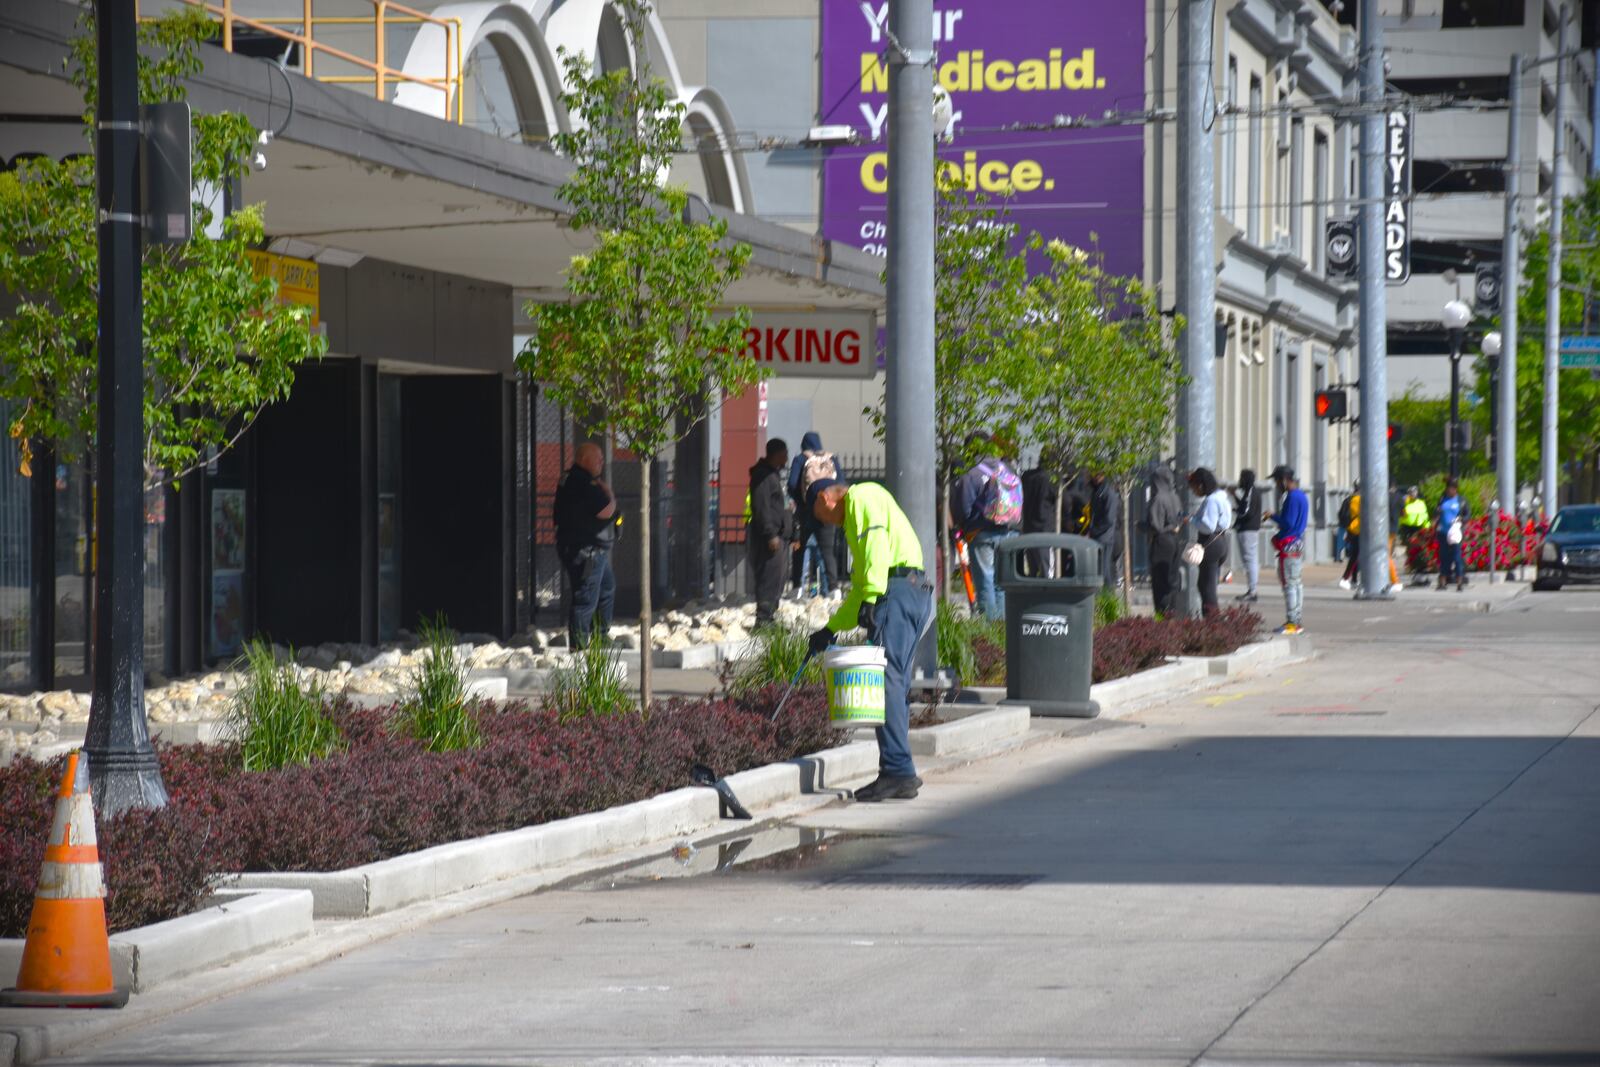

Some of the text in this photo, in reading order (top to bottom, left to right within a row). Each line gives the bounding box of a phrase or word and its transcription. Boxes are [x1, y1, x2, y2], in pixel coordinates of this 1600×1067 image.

[860, 48, 1106, 93] Mdicaid.
[859, 102, 963, 142] Yr
[859, 149, 1056, 194] Coice.
[714, 327, 861, 365] RKING
[1022, 623, 1069, 636] DAYTON
